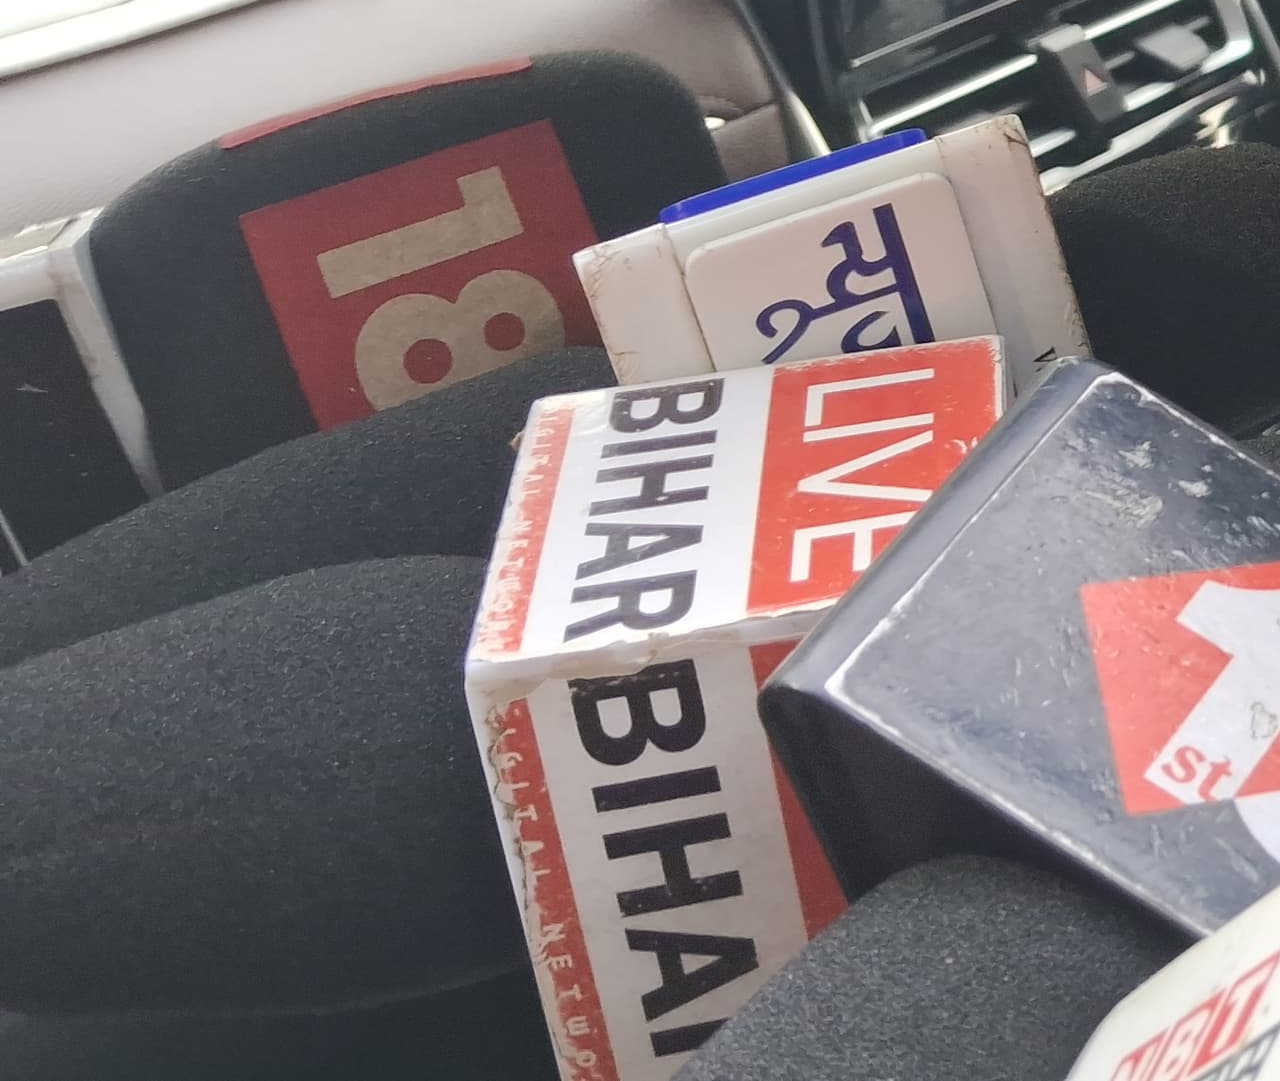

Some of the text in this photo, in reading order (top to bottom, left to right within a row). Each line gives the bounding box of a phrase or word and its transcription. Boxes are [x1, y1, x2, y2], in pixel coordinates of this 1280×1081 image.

[317, 165, 565, 412] 18
[565, 378, 725, 641] BIHAR
[790, 368, 934, 582] LIVE
[567, 658, 759, 1058] BIHA
[541, 922, 600, 1081] NETWO
